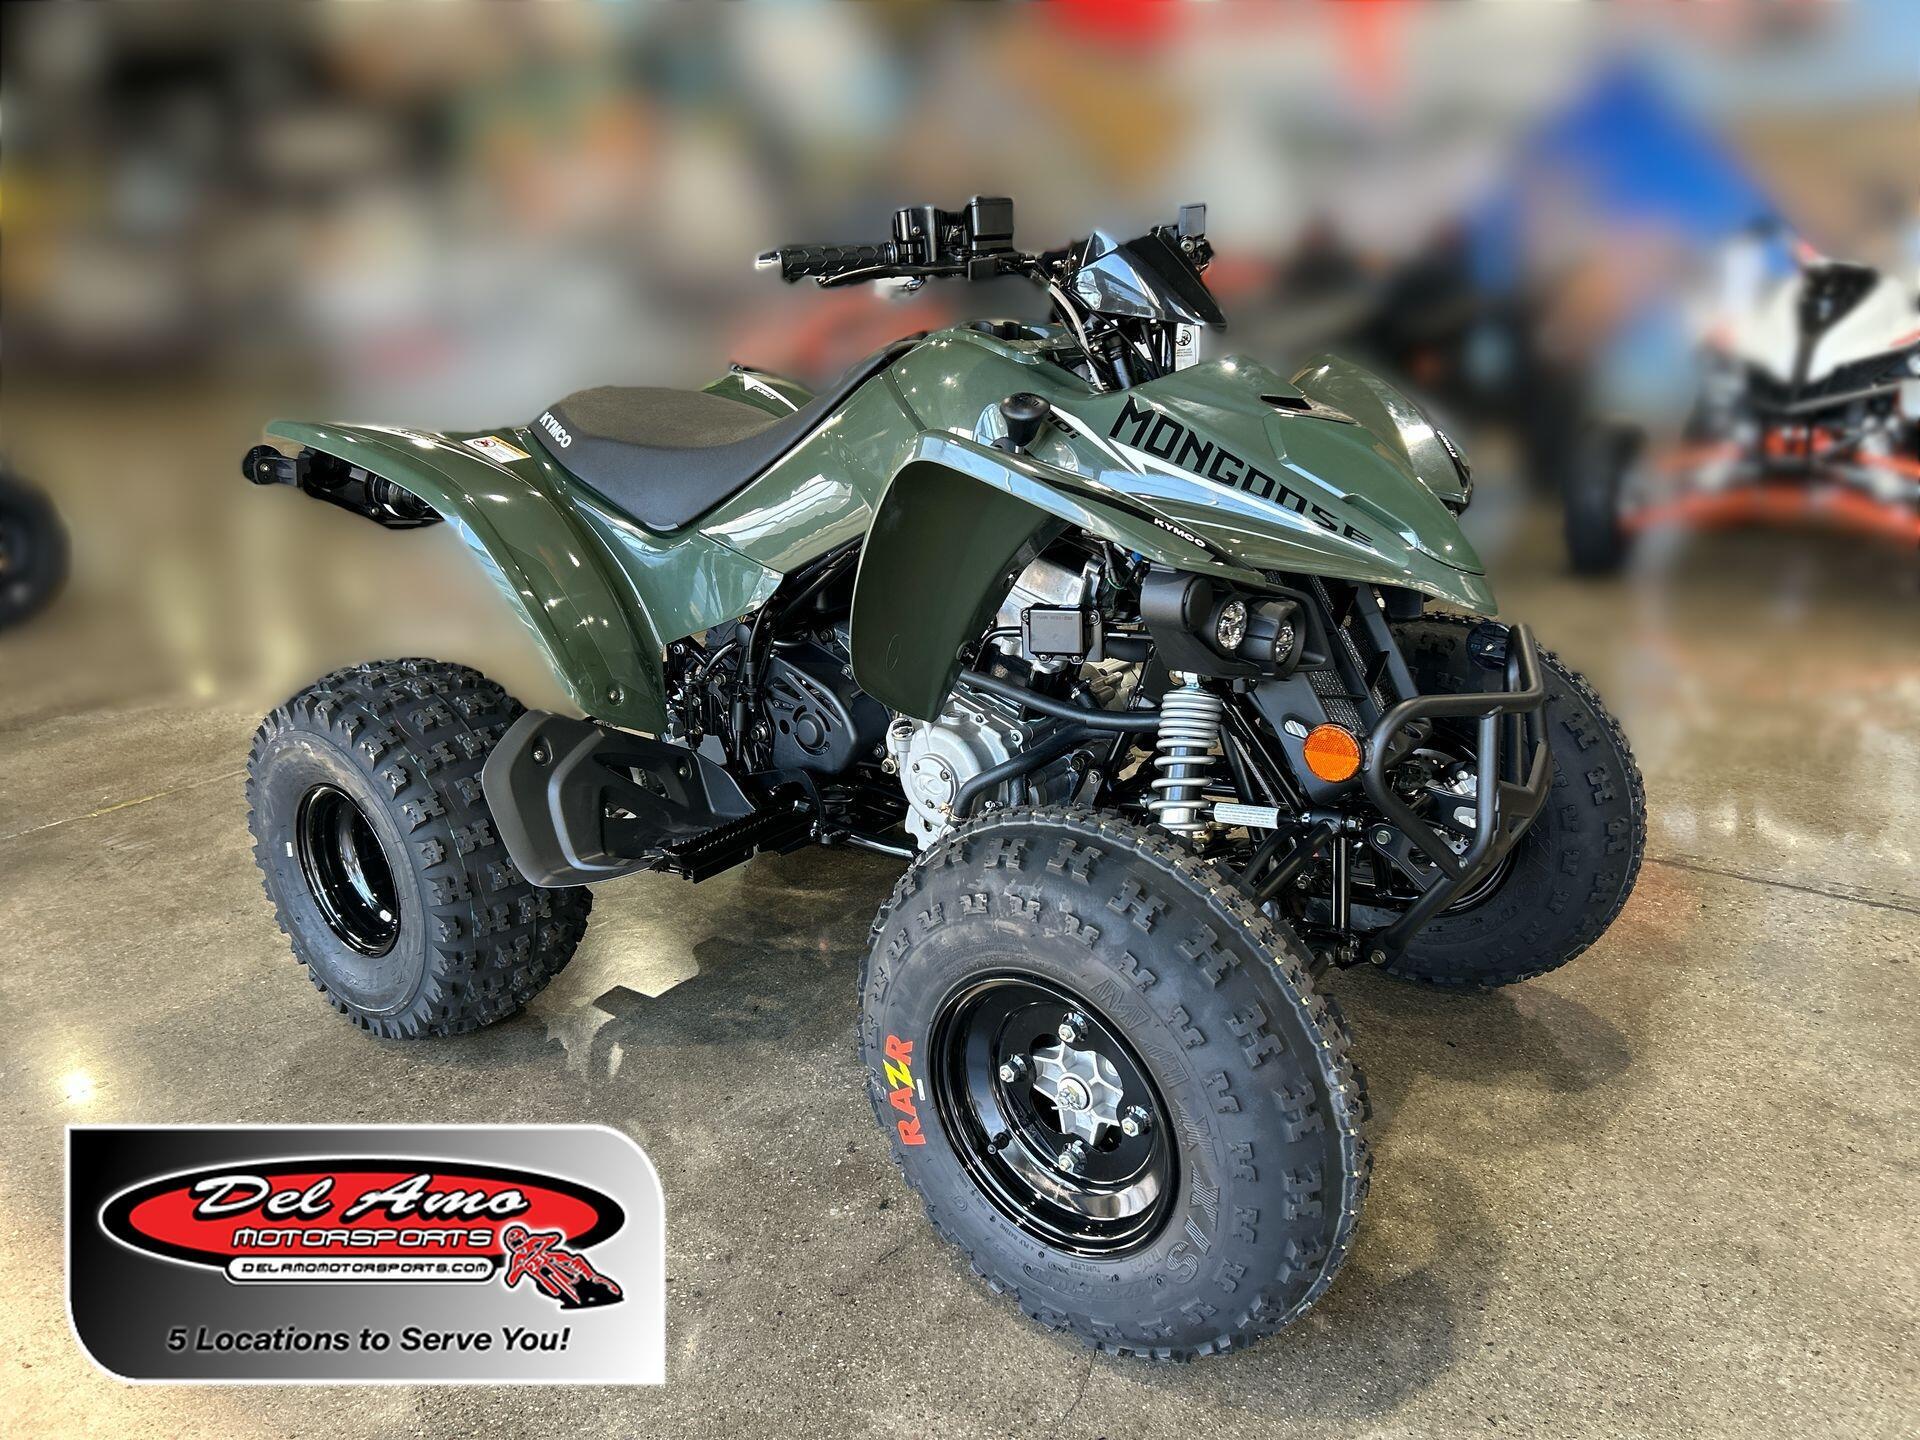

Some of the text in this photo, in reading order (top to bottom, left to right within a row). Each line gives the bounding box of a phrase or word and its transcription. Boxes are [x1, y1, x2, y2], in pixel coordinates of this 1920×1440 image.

[539, 411, 572, 448] KYMCO
[1108, 395, 1373, 548] MONGOOSE
[1153, 517, 1207, 548] KYMCO
[883, 1034, 927, 1145] RAZR
